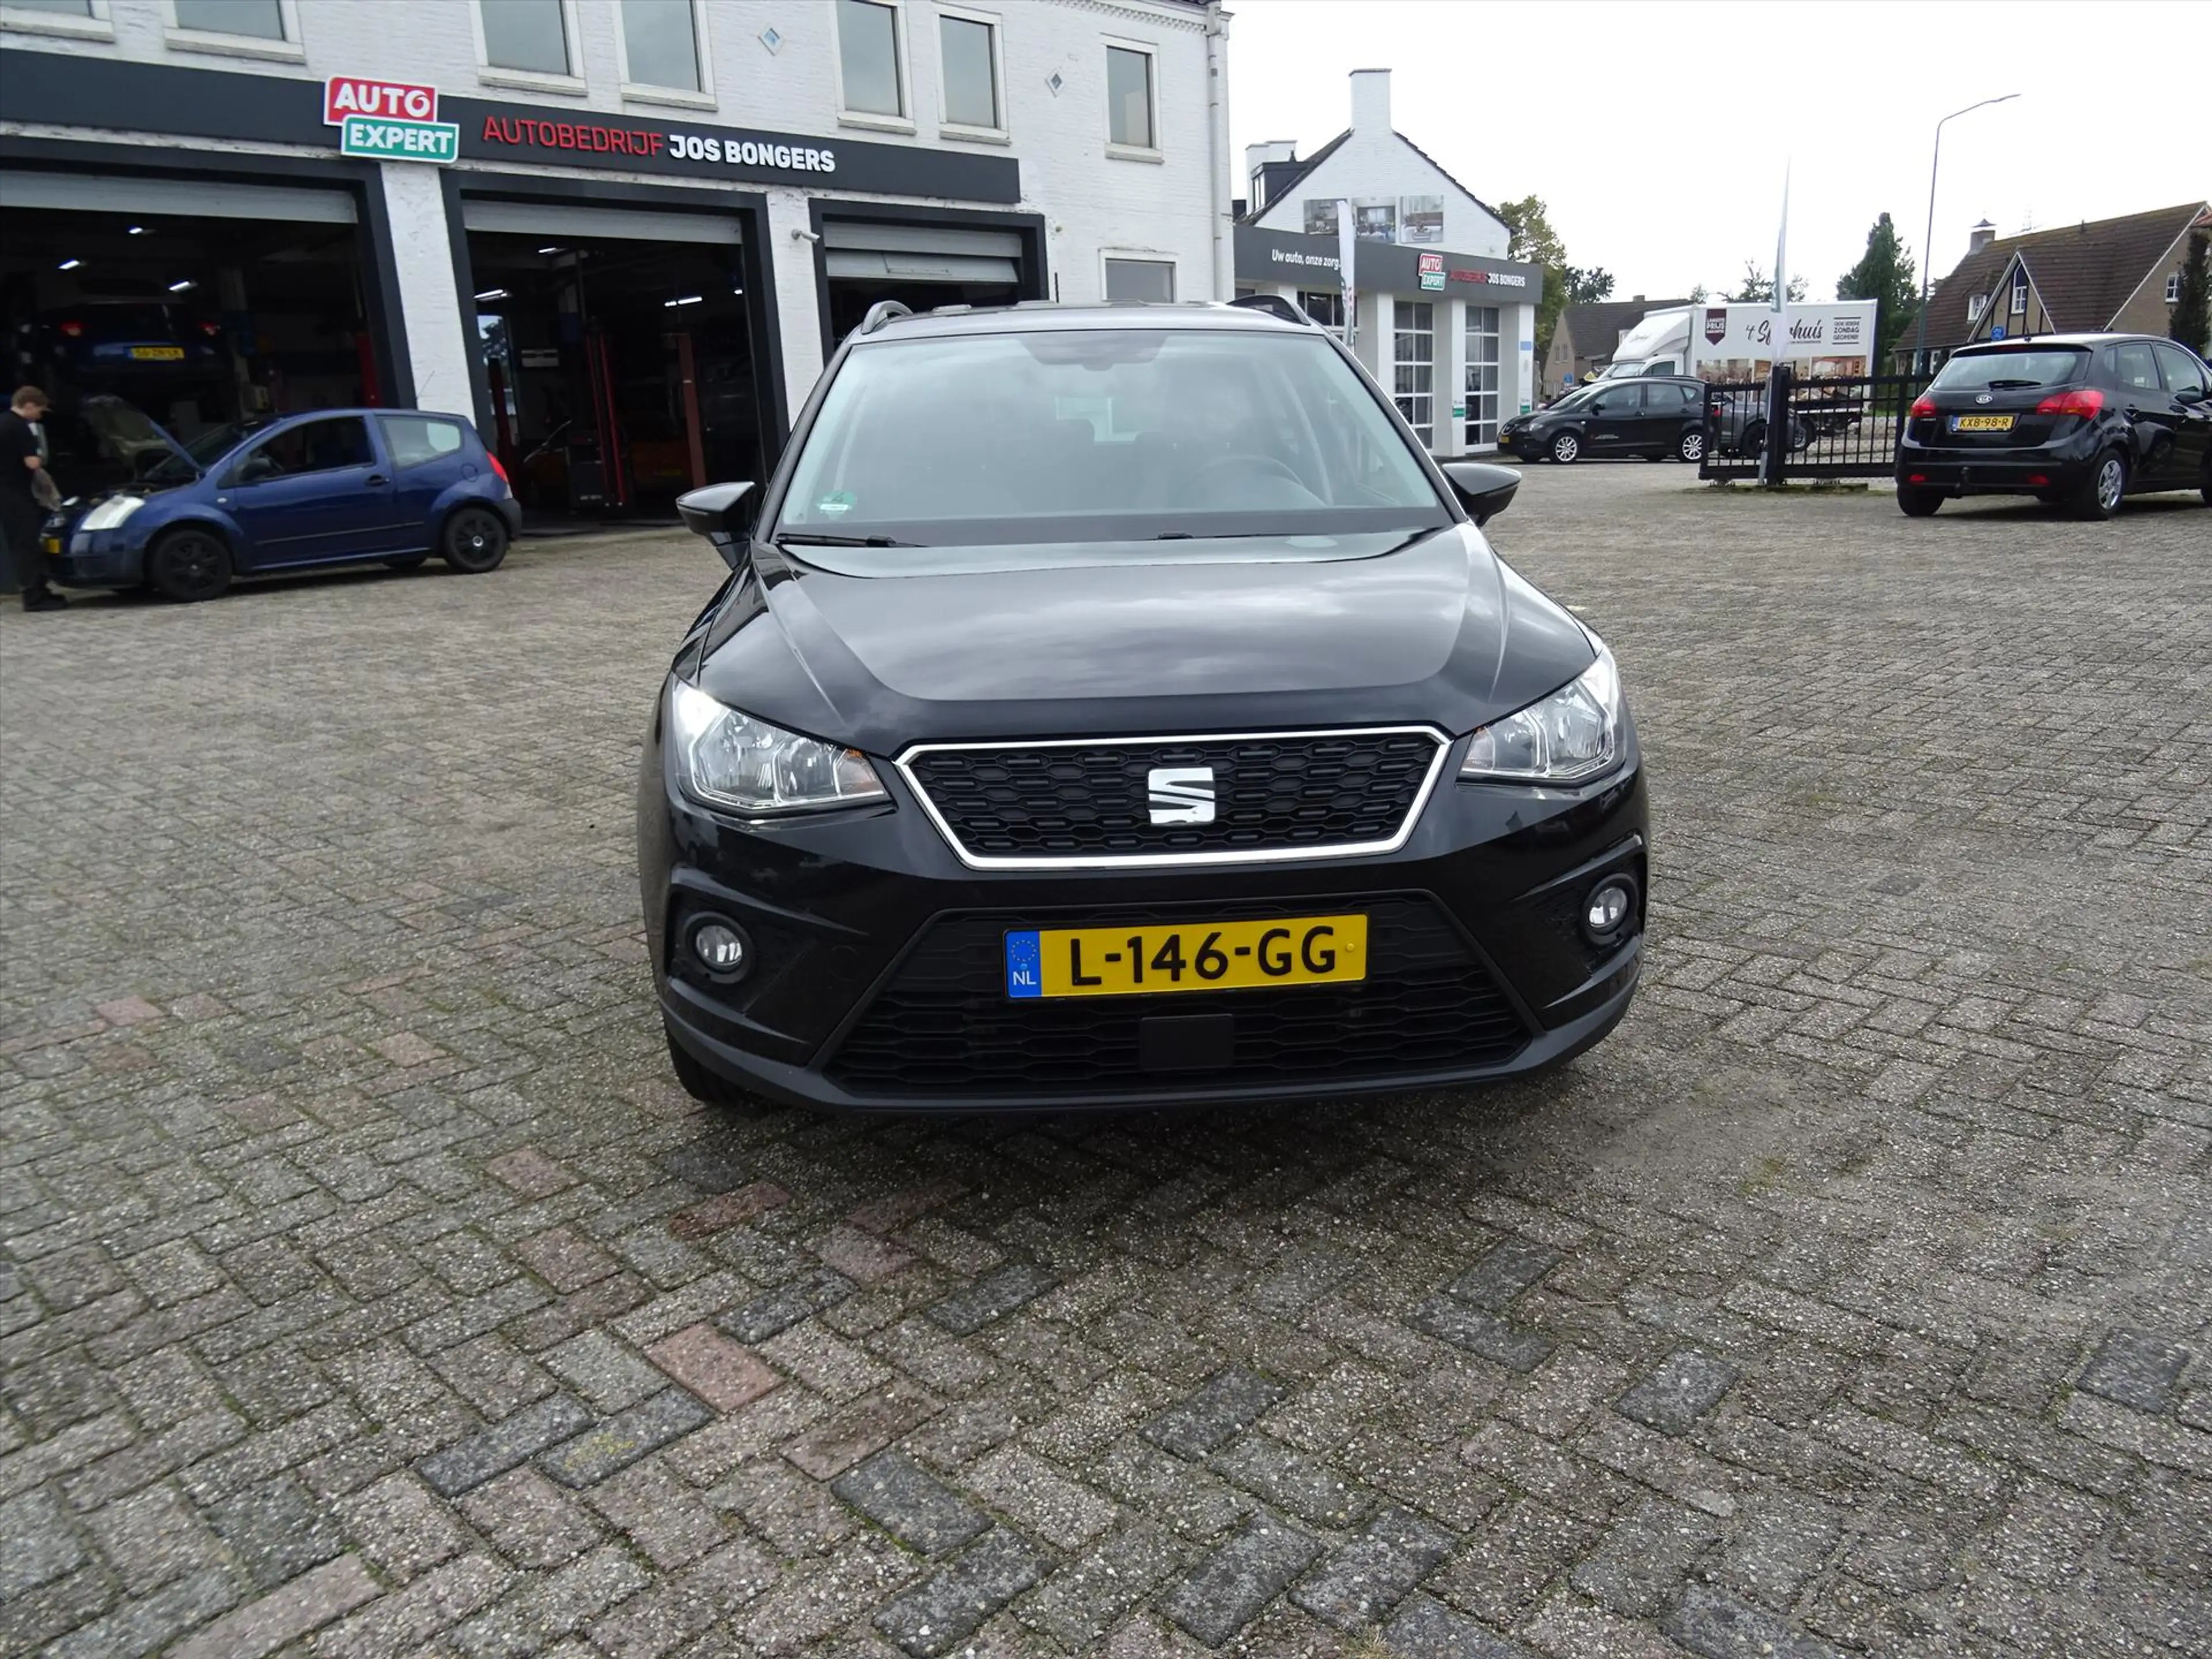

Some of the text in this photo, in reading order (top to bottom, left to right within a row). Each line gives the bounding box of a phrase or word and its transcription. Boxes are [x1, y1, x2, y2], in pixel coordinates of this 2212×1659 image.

[334, 82, 430, 118] AUTO
[349, 123, 453, 153] EXPERT
[483, 116, 835, 172] AUTOBEDRIJF JOS BONGERS
[1271, 249, 1284, 262] Uw
[1305, 255, 1323, 266] onze
[1422, 257, 1441, 271] AUTO
[1487, 272, 1498, 285] JOS
[1499, 274, 1526, 287] BONGERS
[1960, 417, 2009, 427] KXB-98-R
[1013, 925, 1336, 987] NL L-146-GG
